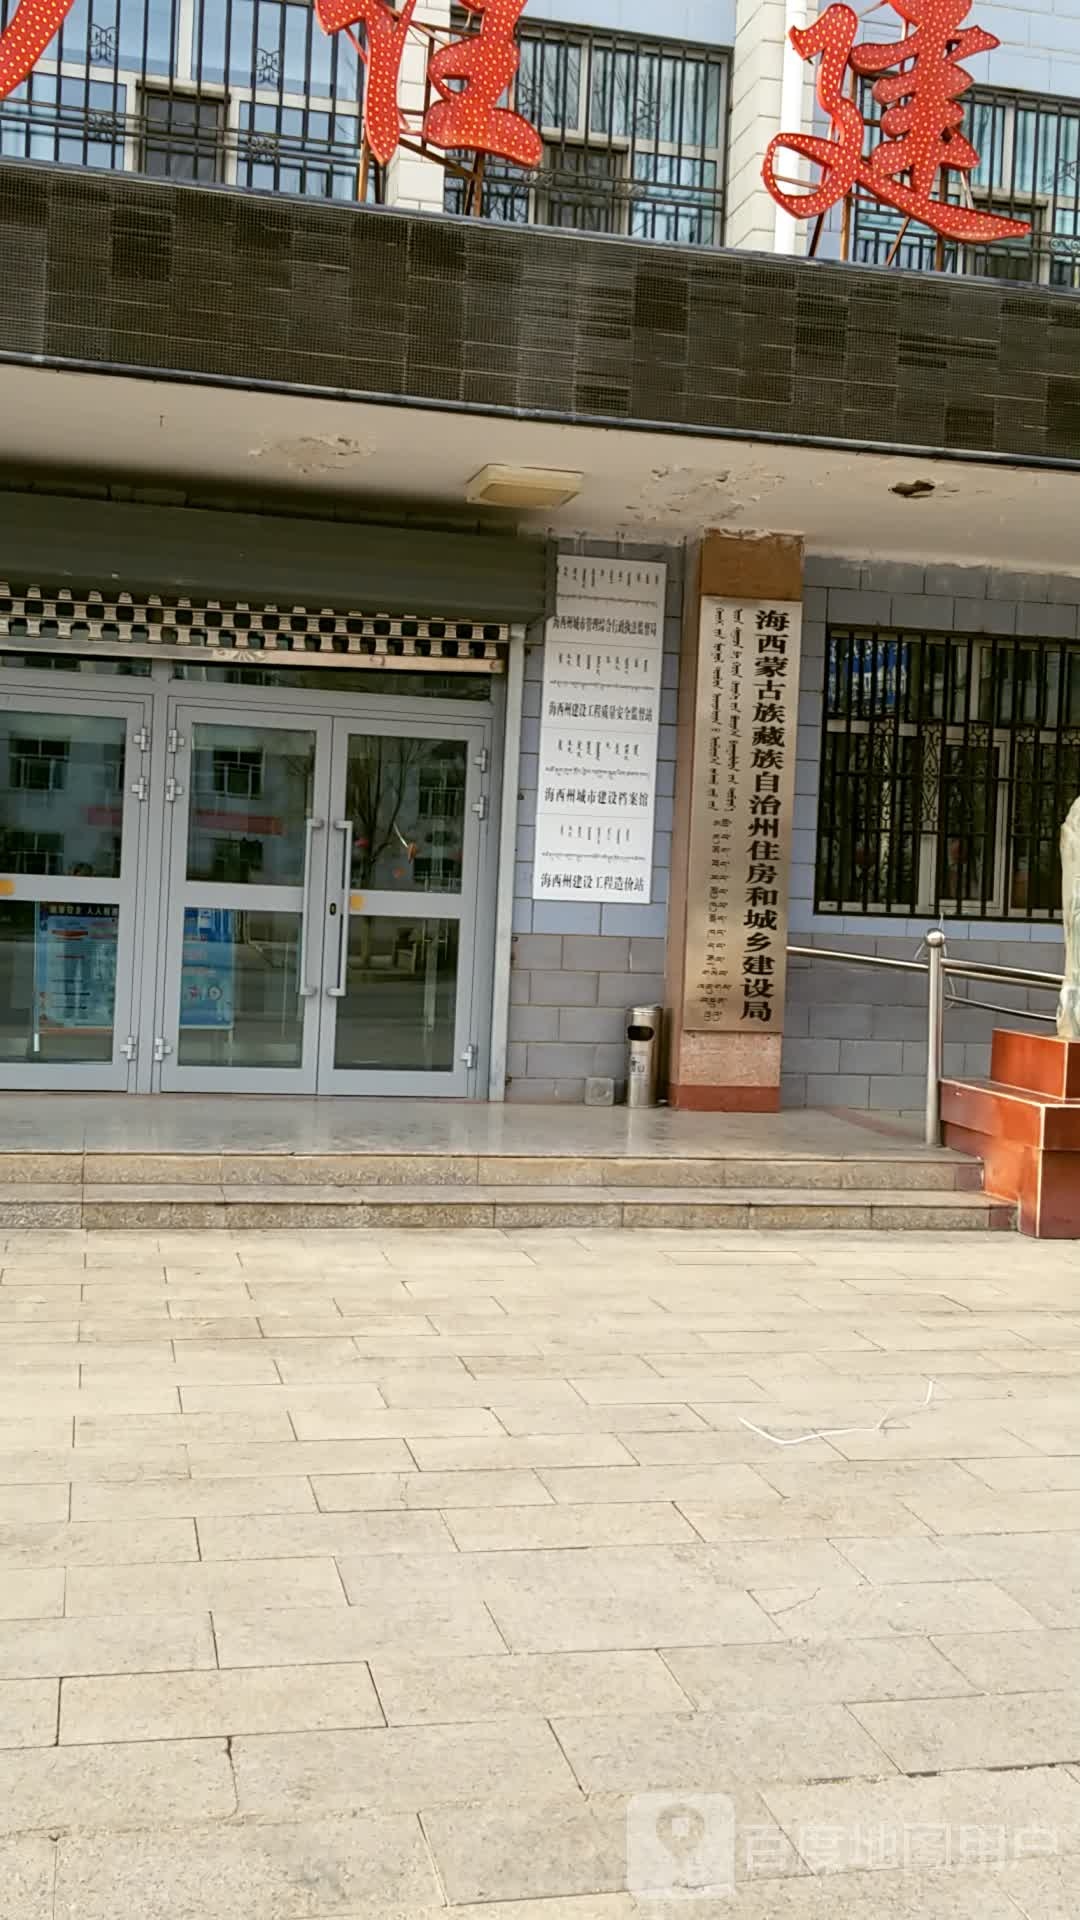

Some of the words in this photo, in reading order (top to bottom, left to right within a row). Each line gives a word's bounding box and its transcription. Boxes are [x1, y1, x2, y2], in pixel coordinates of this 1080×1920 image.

[544, 786, 649, 807] 海西州城市建设档案馆
[740, 608, 791, 1023] 海西蒙古族藏族自治州住房和城乡建设局
[540, 872, 645, 892] 海西州建设工程造价站
